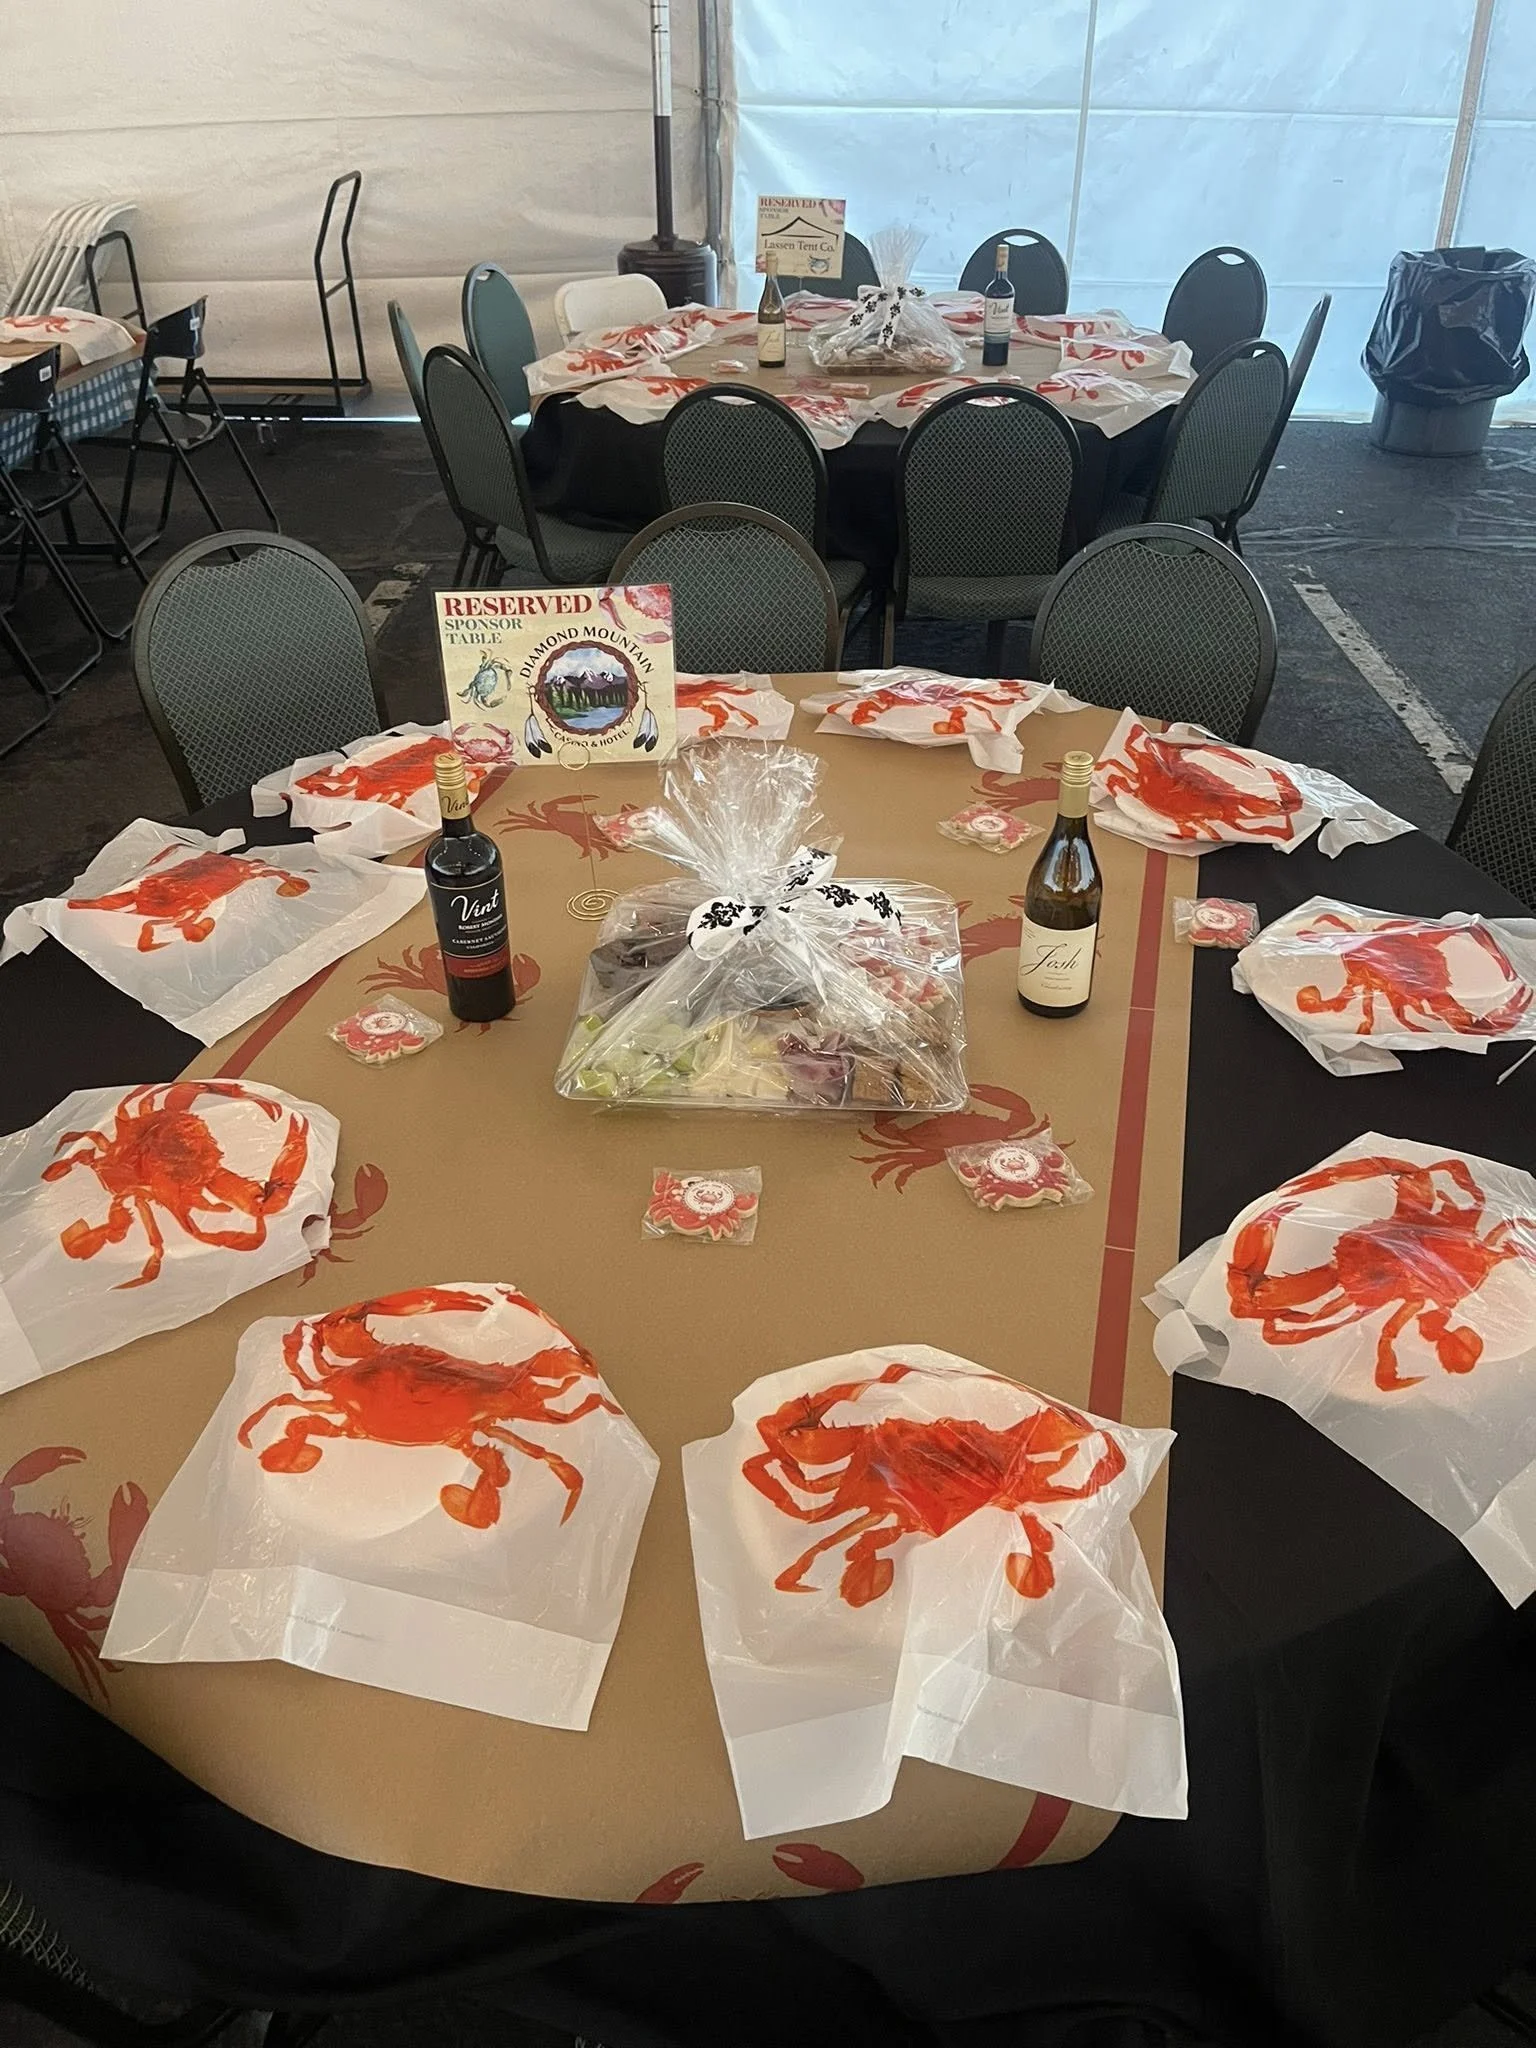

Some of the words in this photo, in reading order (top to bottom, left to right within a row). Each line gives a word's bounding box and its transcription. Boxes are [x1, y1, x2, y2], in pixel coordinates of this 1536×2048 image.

[760, 198, 817, 208] RESERVED
[764, 239, 795, 250] Lassen
[797, 240, 818, 251] Tent
[820, 242, 835, 252] Co.
[442, 594, 592, 616] RESERVED
[445, 618, 523, 631] SPONSOR
[446, 633, 502, 645] TABLE
[519, 627, 579, 679] DIAMOND
[583, 626, 655, 674] MOUNTAIN
[554, 731, 589, 748] CASINO
[599, 729, 629, 747] HOTEL
[450, 888, 499, 922] Vint
[1020, 943, 1082, 976] Josh
